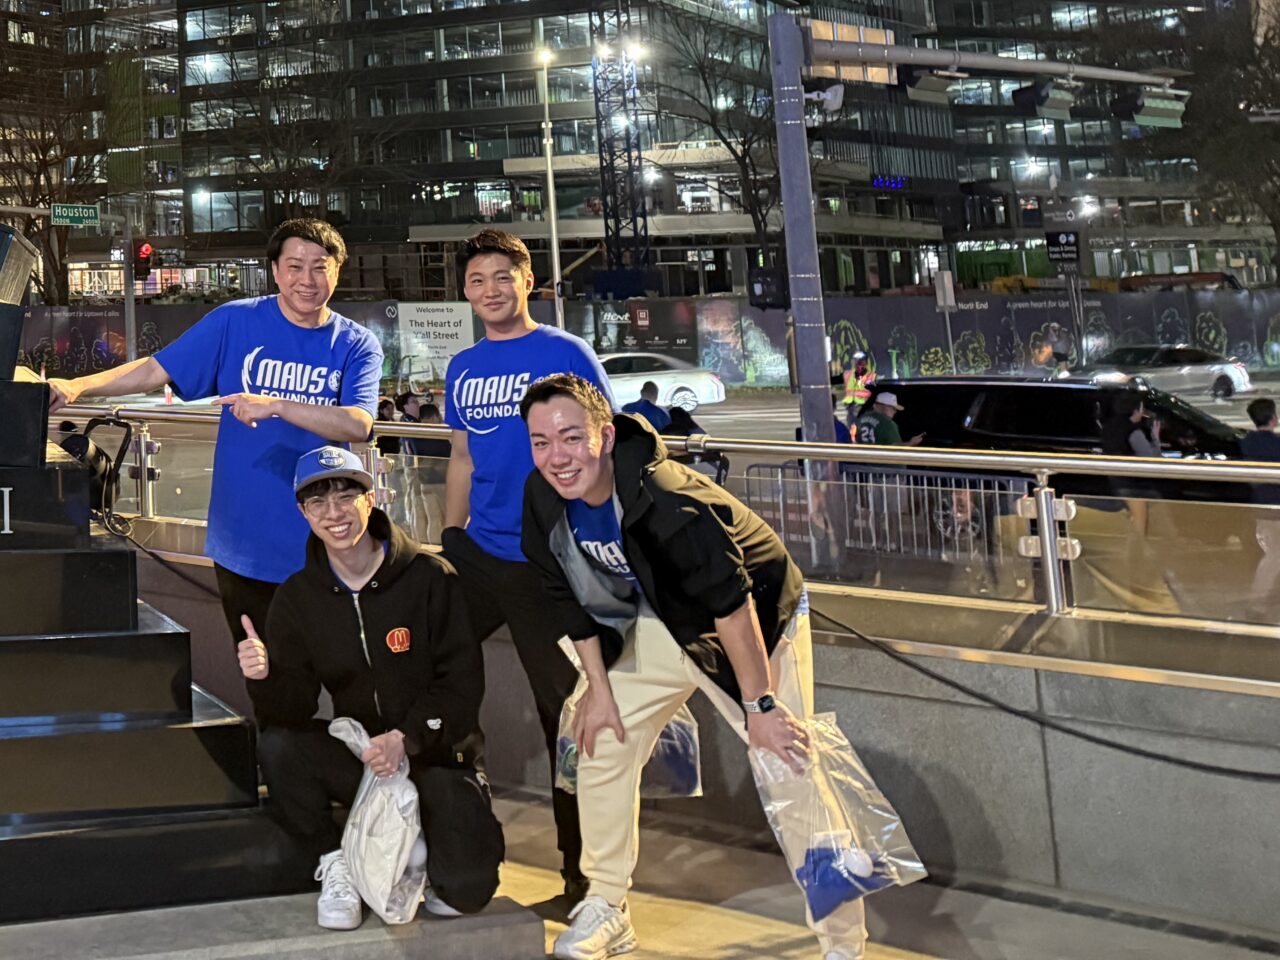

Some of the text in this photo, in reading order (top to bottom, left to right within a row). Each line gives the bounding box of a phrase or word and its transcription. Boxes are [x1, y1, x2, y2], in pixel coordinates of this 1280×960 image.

[55, 206, 95, 217] Houston
[409, 320, 463, 328] The Heart of
[433, 331, 459, 339] Street
[256, 358, 328, 393] MAVS
[461, 372, 531, 408] MAVS
[466, 403, 521, 420] FOUNDA
[861, 426, 876, 444] 24
